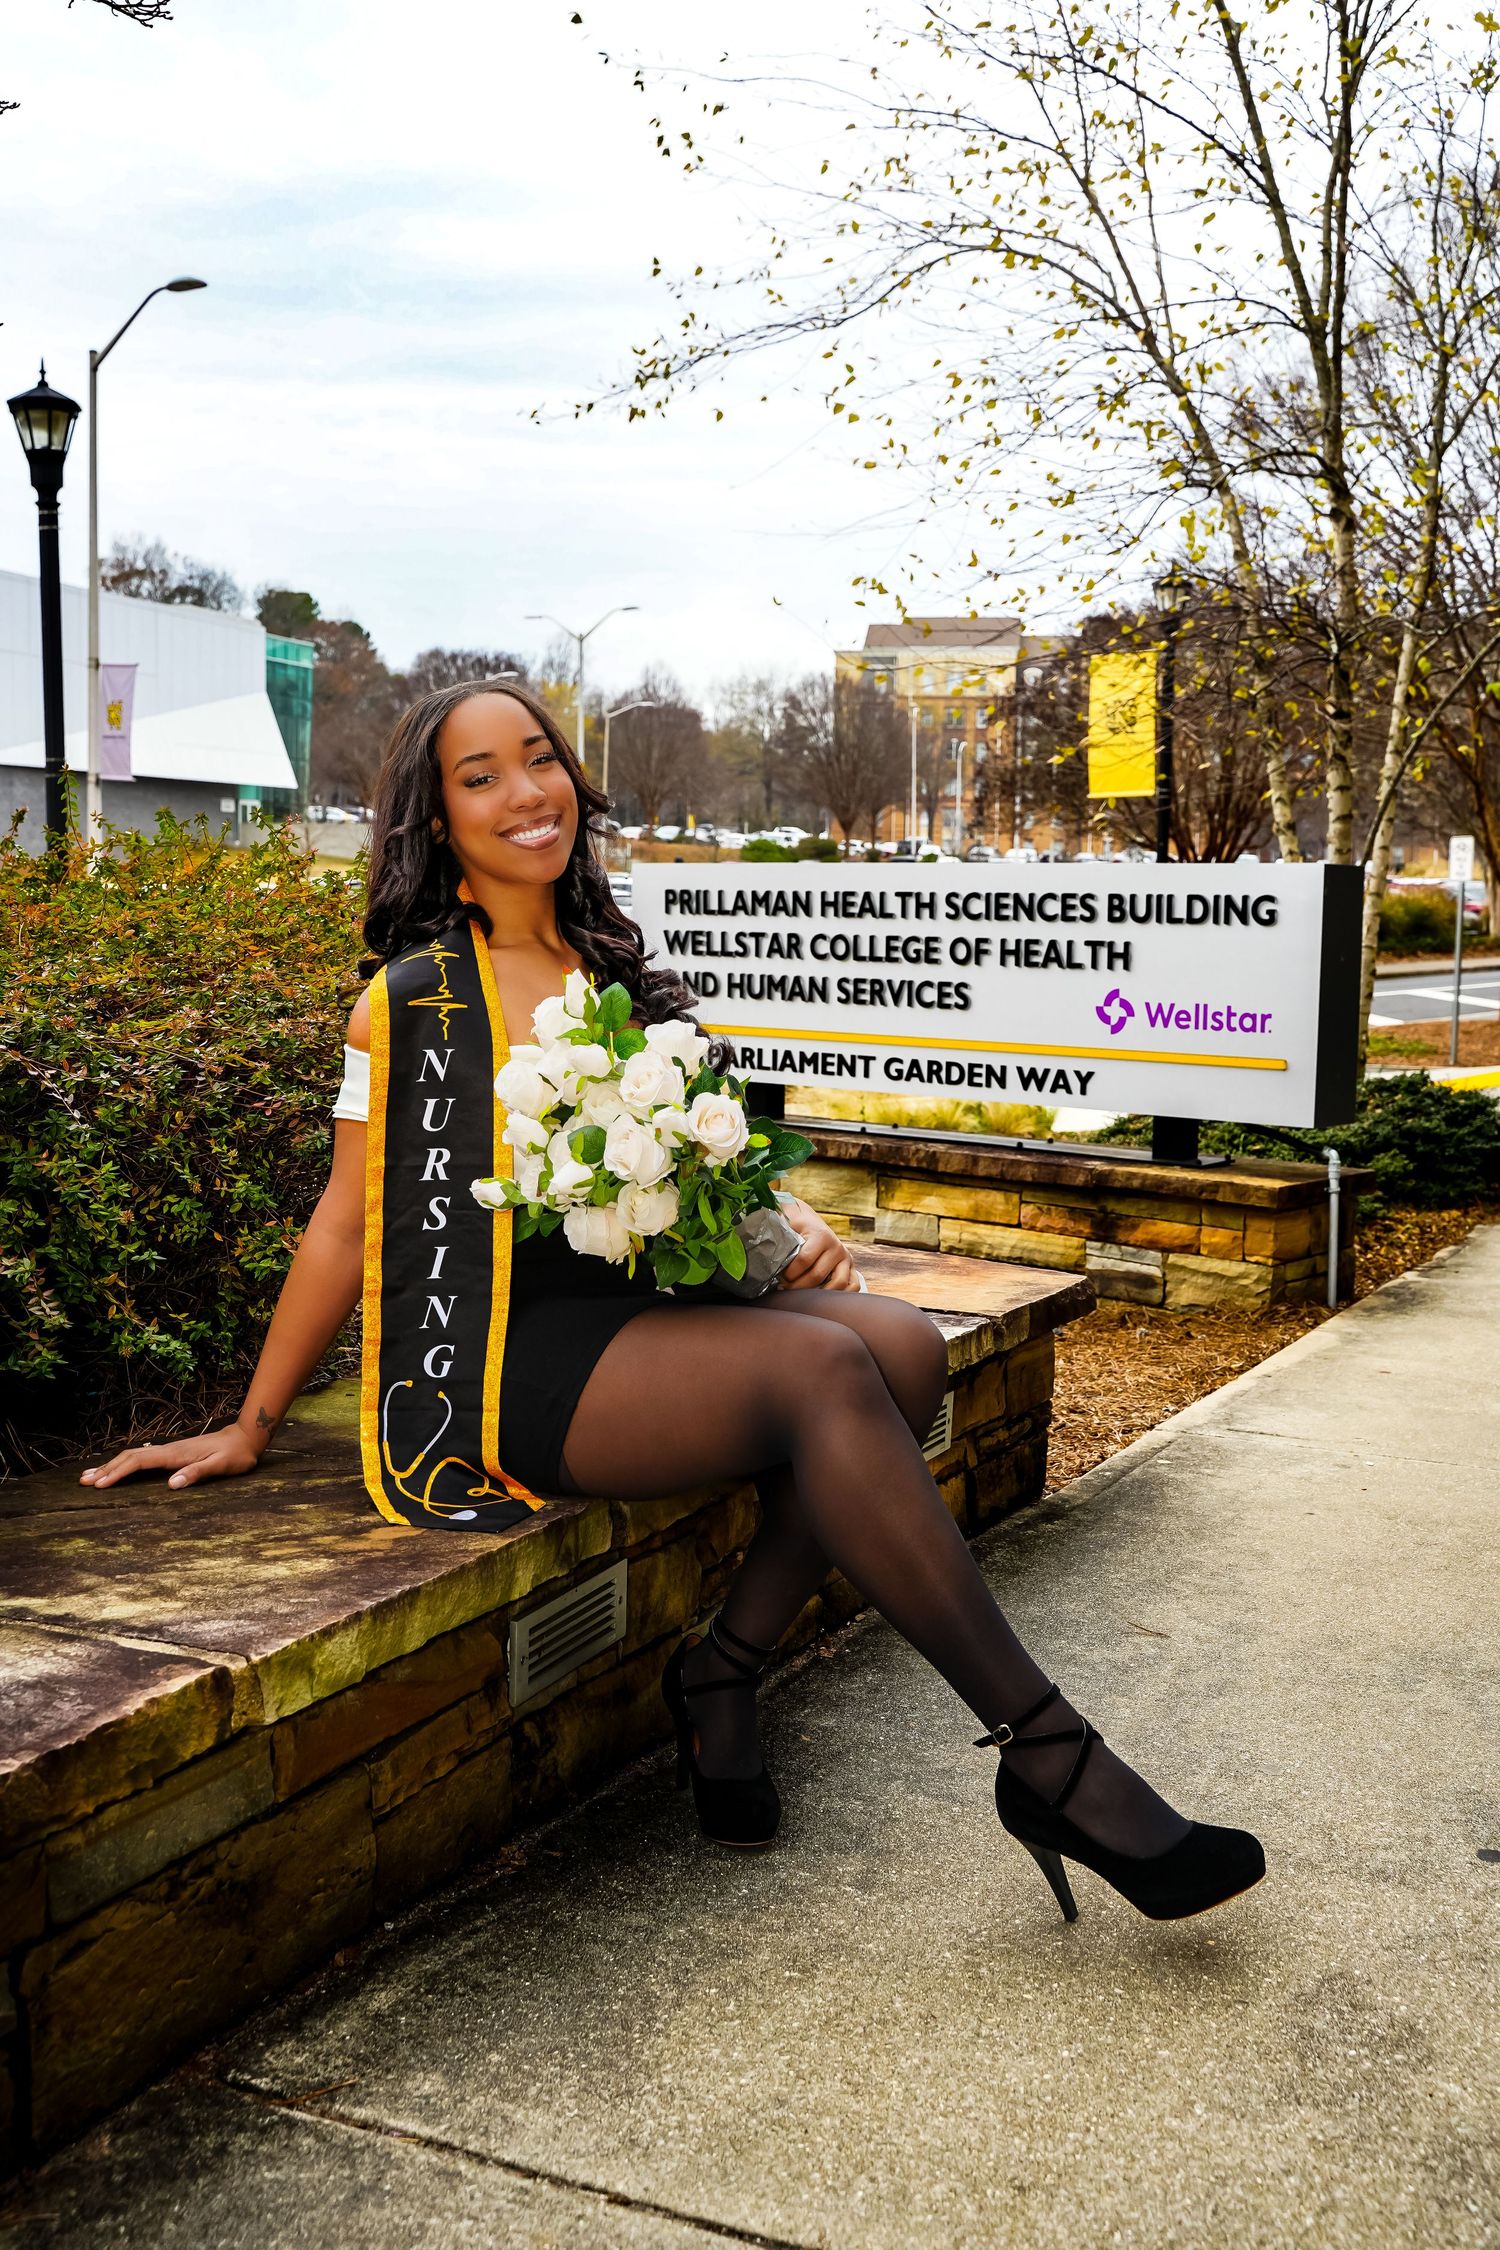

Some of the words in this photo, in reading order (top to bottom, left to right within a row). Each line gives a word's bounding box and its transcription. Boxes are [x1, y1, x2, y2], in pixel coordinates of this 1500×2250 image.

[664, 889, 812, 918] PRILLAMAN
[820, 890, 936, 920] HEALTH
[944, 891, 1097, 923] SCIENCES
[1106, 893, 1279, 927] BUILDING
[663, 930, 803, 960] WELLSTAR
[810, 933, 941, 965] COLLEGE
[949, 937, 992, 966] OF
[1000, 938, 1132, 972] HEALTH
[682, 971, 721, 998] ND
[727, 972, 829, 1004] HUMAN
[836, 976, 971, 1011] SERVICES
[883, 1057, 1007, 1089] GARDEN
[1016, 1066, 1096, 1096] WAY
[416, 1047, 457, 1380] NURSING
